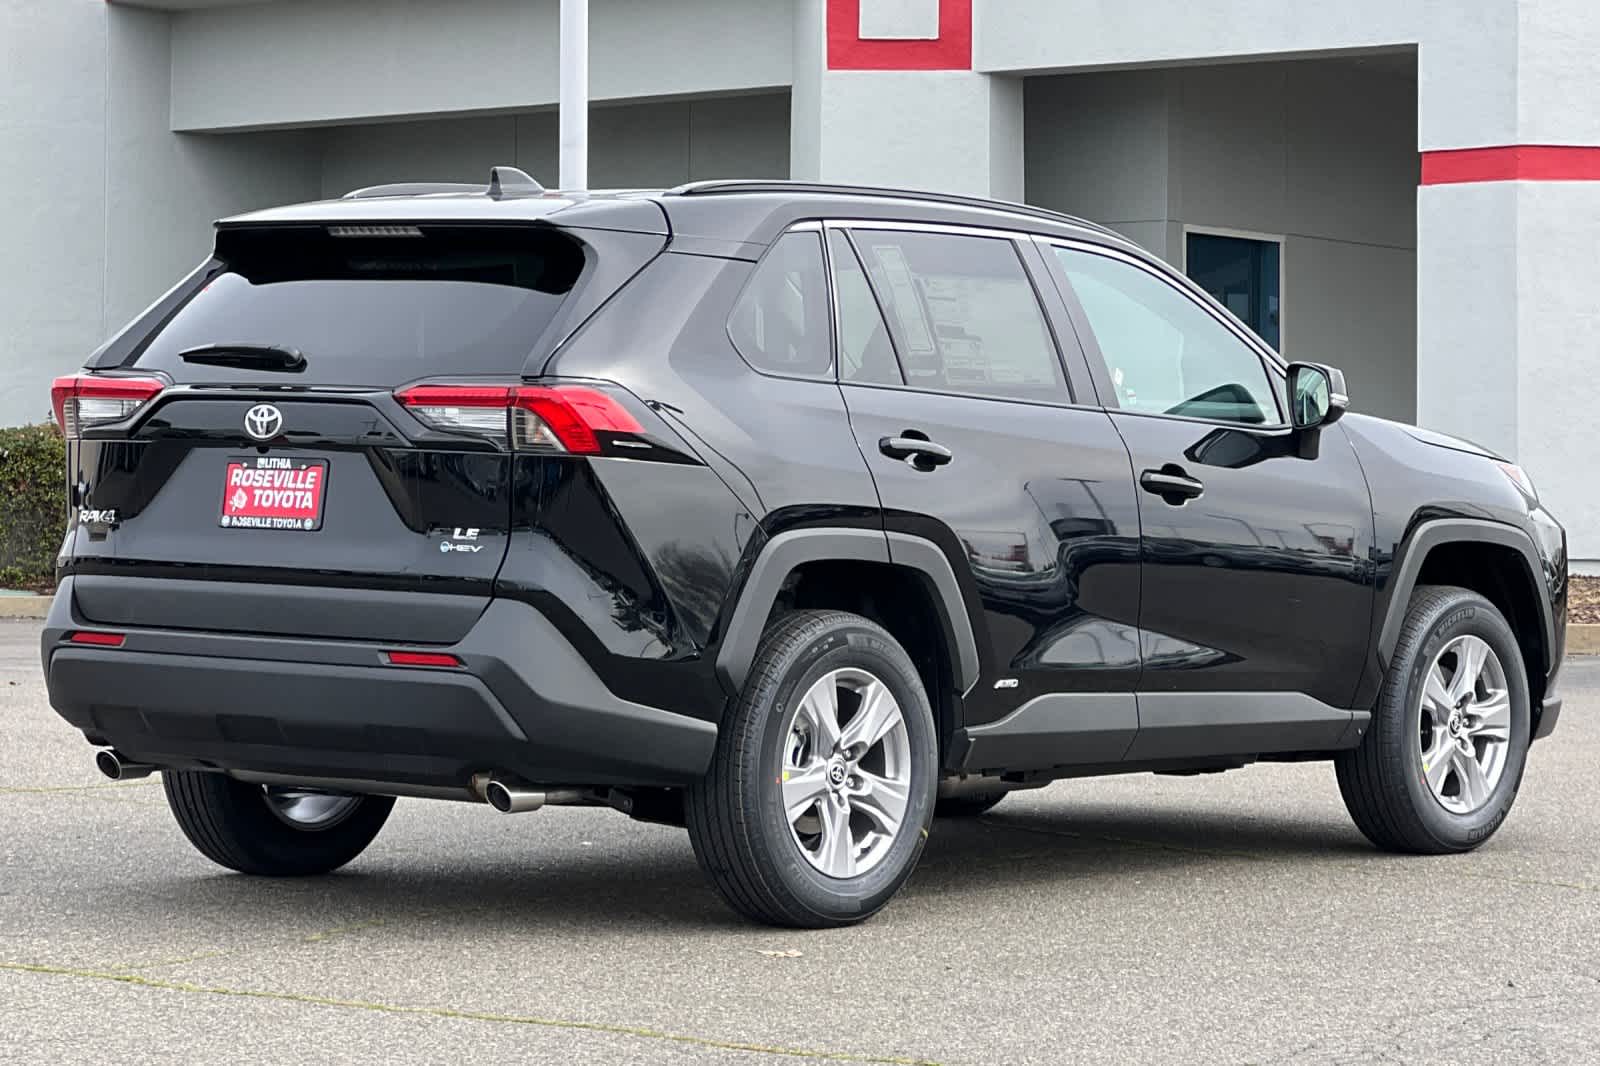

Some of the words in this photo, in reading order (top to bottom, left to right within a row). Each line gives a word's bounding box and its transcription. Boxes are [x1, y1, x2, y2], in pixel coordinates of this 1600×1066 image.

[265, 458, 292, 469] LITHIA
[231, 468, 317, 489] ROSEVILLE
[253, 489, 313, 509] TOYOTA
[80, 509, 116, 523] RAV4
[273, 518, 302, 529] TOYOTA
[453, 528, 480, 540] LE
